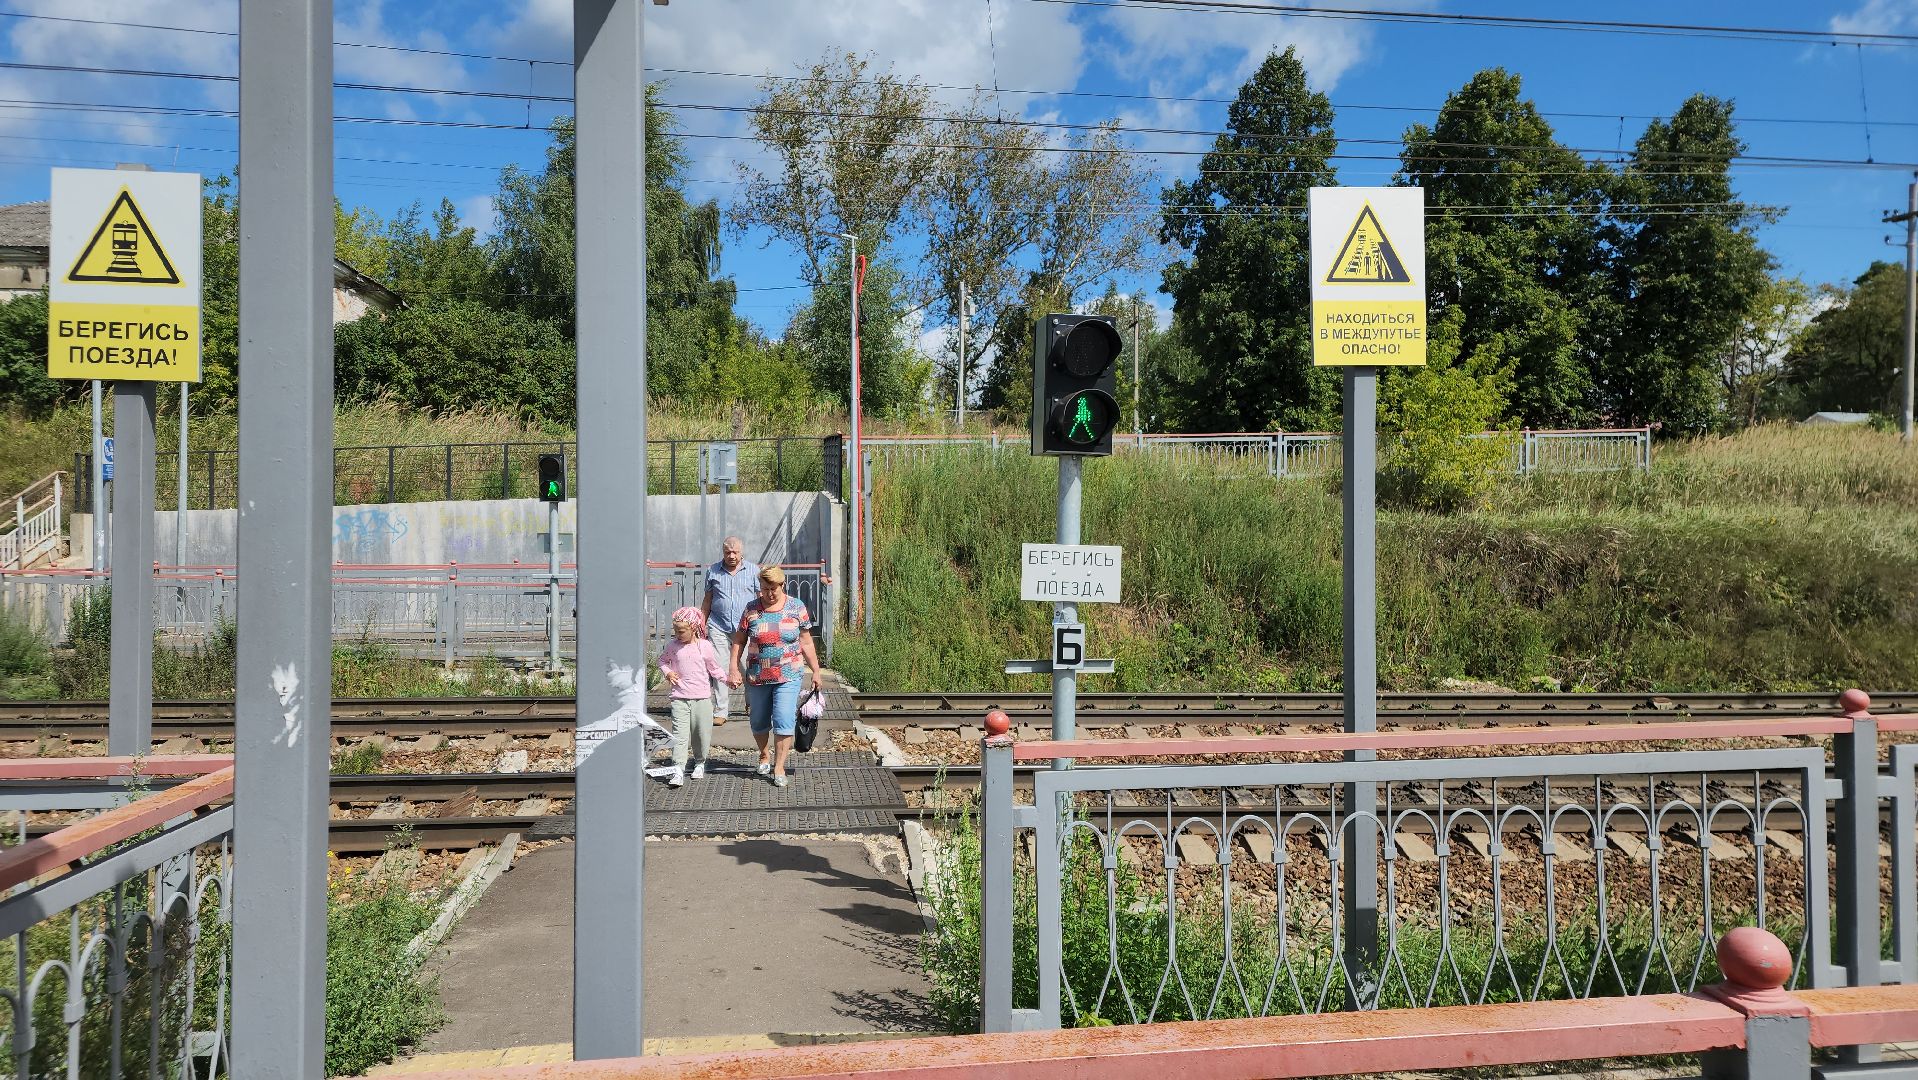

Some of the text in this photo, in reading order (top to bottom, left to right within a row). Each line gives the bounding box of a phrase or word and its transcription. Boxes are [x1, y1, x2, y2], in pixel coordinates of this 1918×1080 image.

[1326, 313, 1415, 325] НАХОДИТЬСЯ
[58, 320, 189, 341] БЕРЕГИСЬ
[1320, 328, 1422, 340] В МЕЖДУПУТЬЕ
[69, 346, 177, 368] ПОЕЗДА!
[1341, 343, 1401, 355] ОПАСНО!
[1028, 550, 1114, 567] БЕРЕГИСЬ
[1036, 580, 1105, 597] ПОЕЗДА
[1056, 628, 1082, 665] Б
